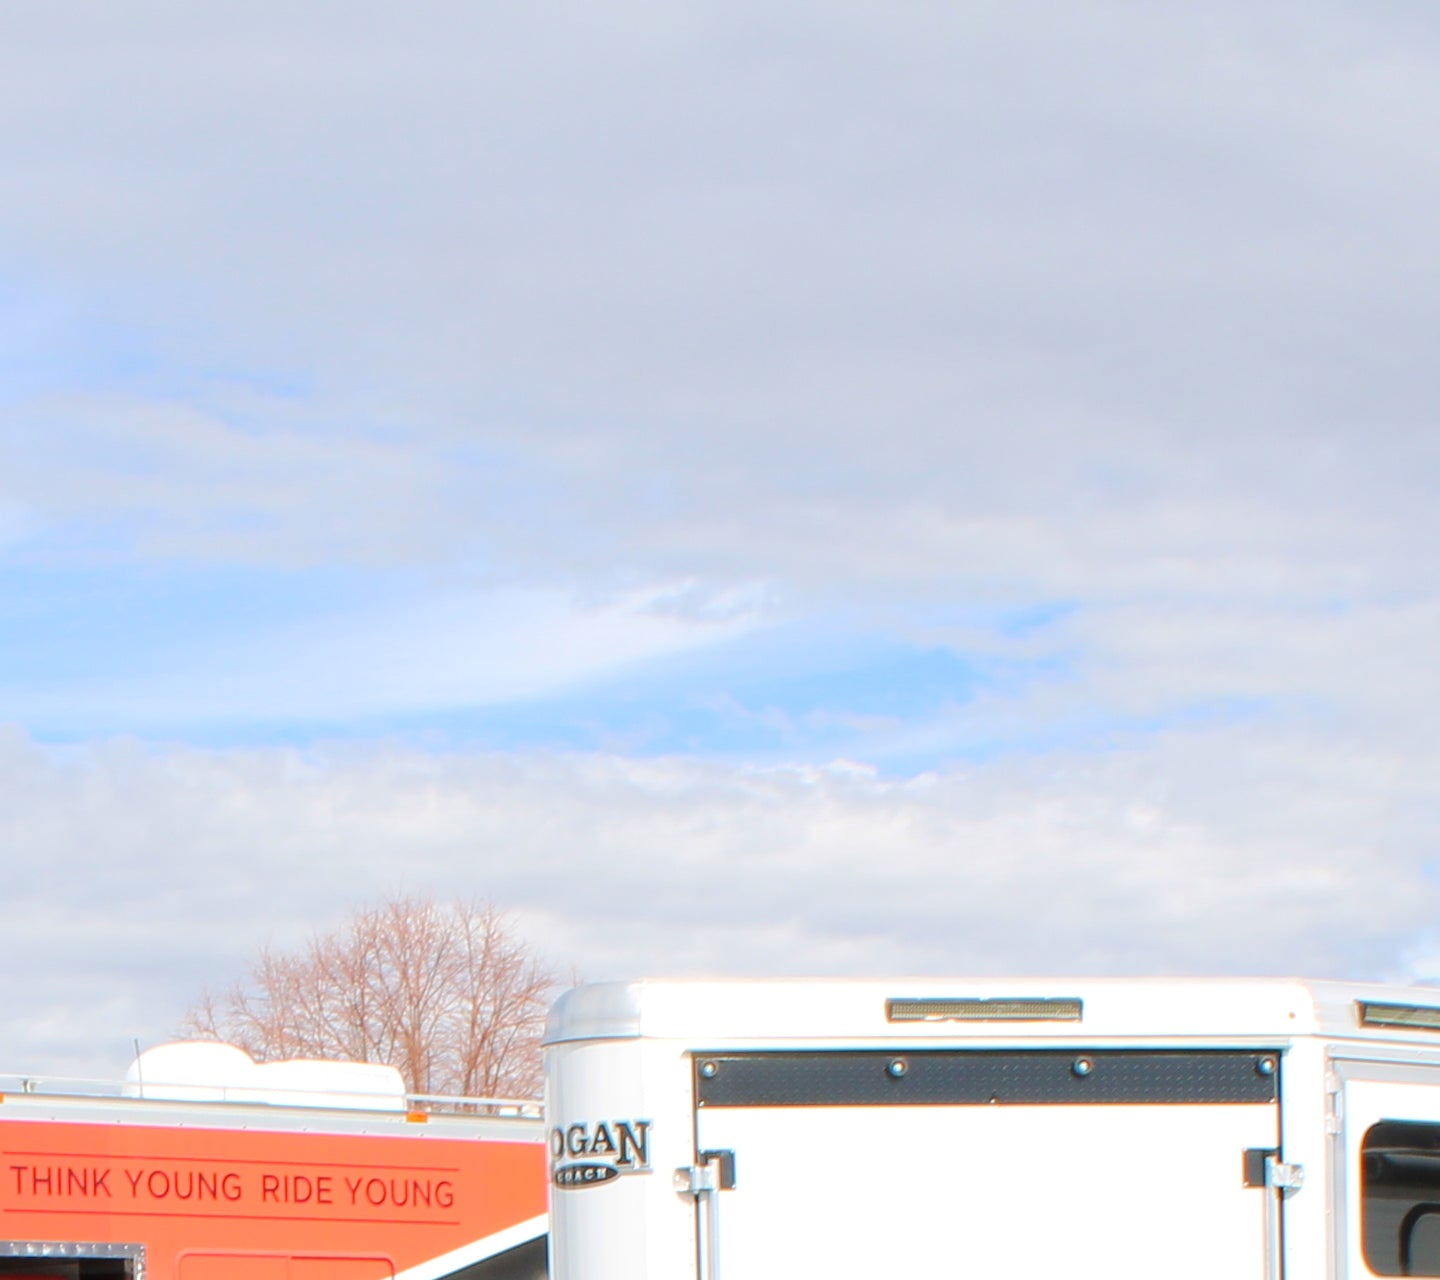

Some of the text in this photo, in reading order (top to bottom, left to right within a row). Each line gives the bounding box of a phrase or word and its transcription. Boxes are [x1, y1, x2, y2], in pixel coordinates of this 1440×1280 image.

[550, 1119, 653, 1167] OGAN
[9, 1165, 456, 1209] THINK YOUNG RIDE YOUNG
[556, 1167, 608, 1183] COACH
